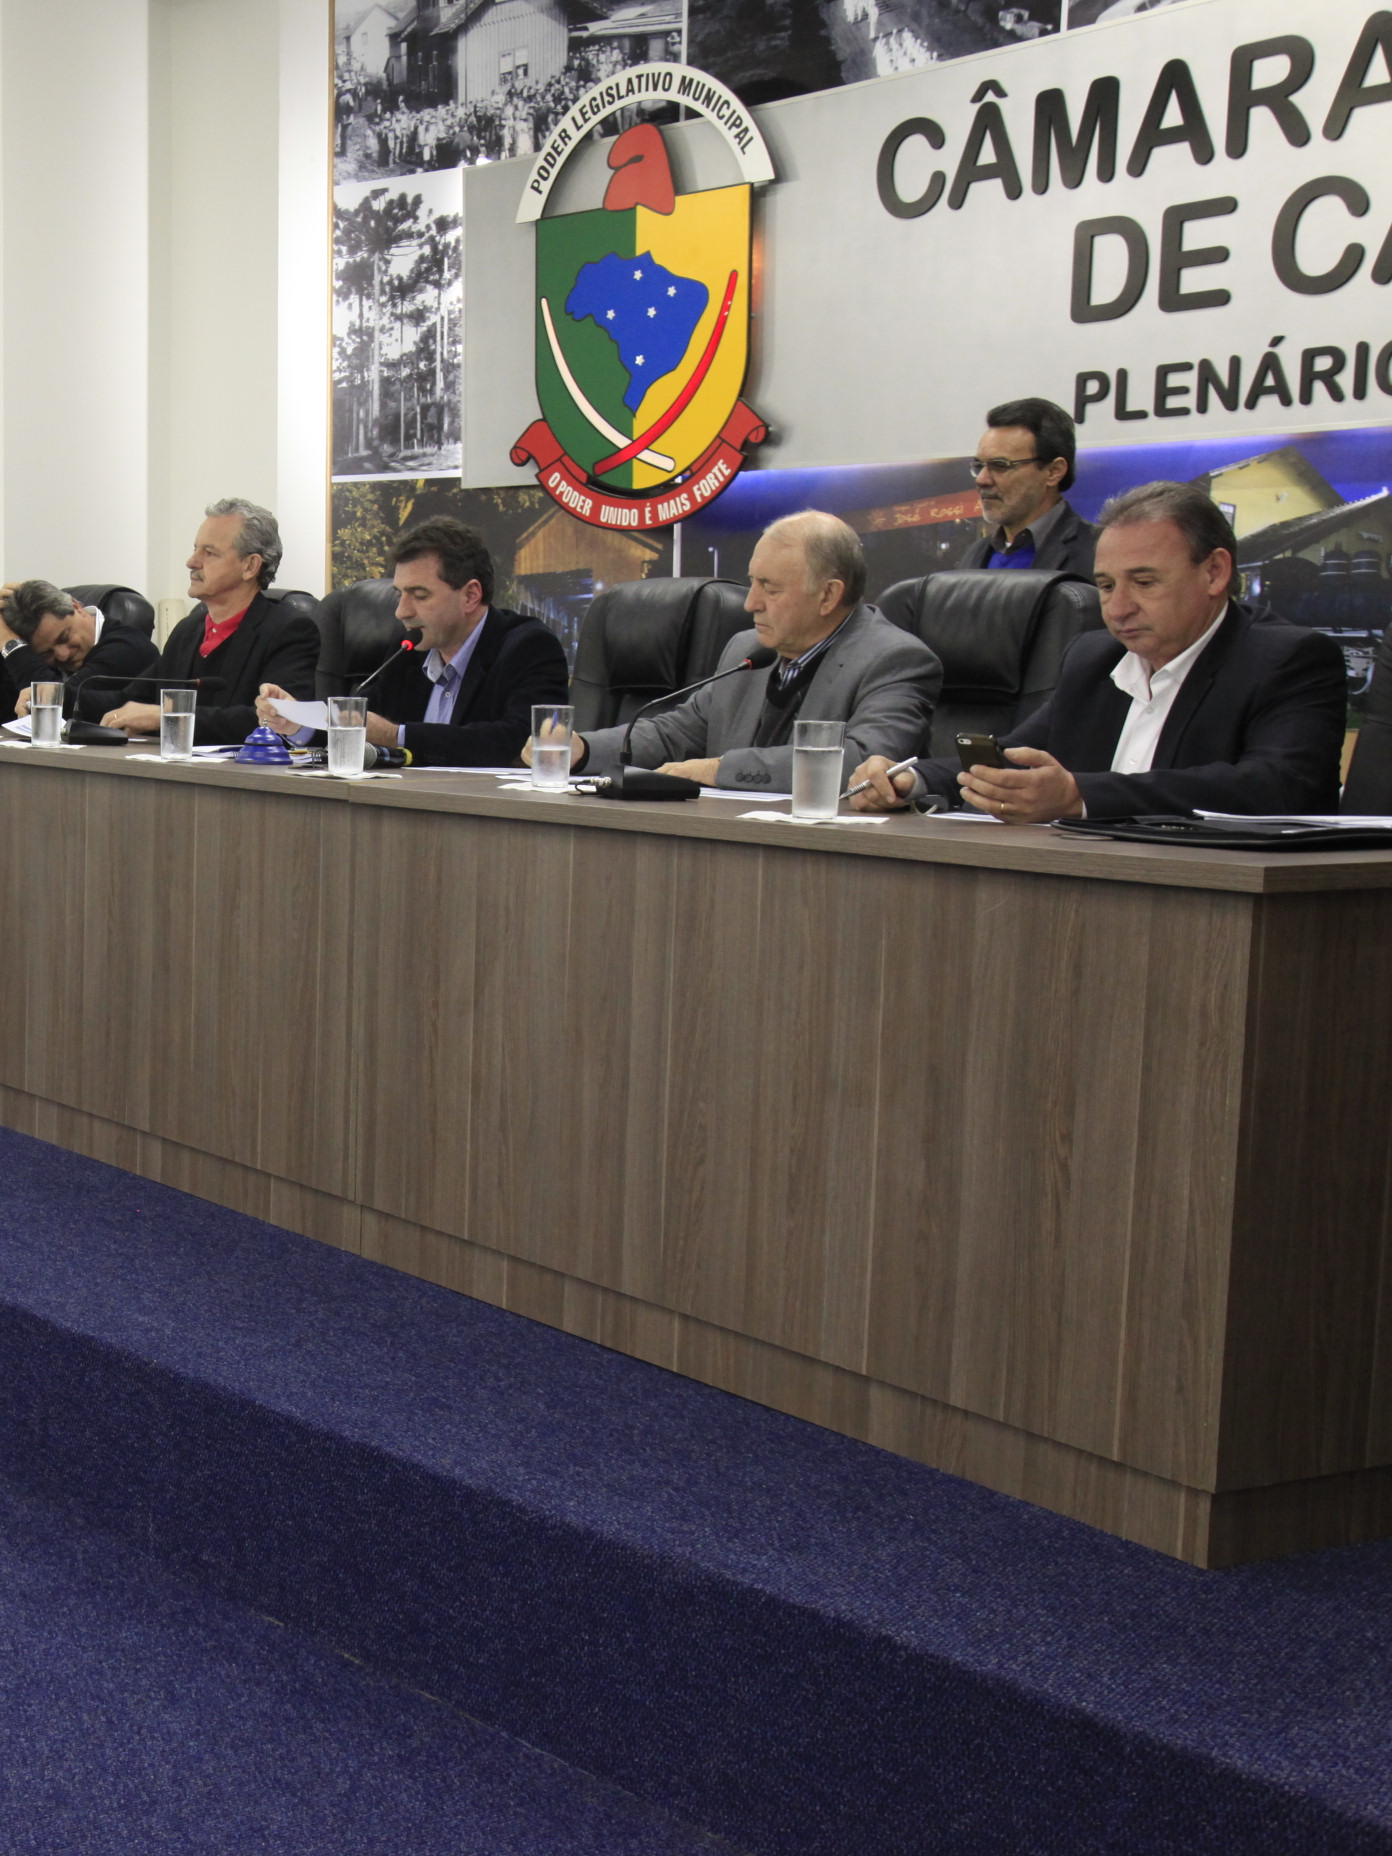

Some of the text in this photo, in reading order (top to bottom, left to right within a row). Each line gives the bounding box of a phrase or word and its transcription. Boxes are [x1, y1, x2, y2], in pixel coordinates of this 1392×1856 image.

[530, 71, 755, 195] PODER LEGISLATIVO MUNICIPAL
[876, 10, 1392, 219] CÂMARA
[1070, 175, 1392, 324] DE C
[548, 459, 731, 526] O PODER UNIDO É MAIS FORTE
